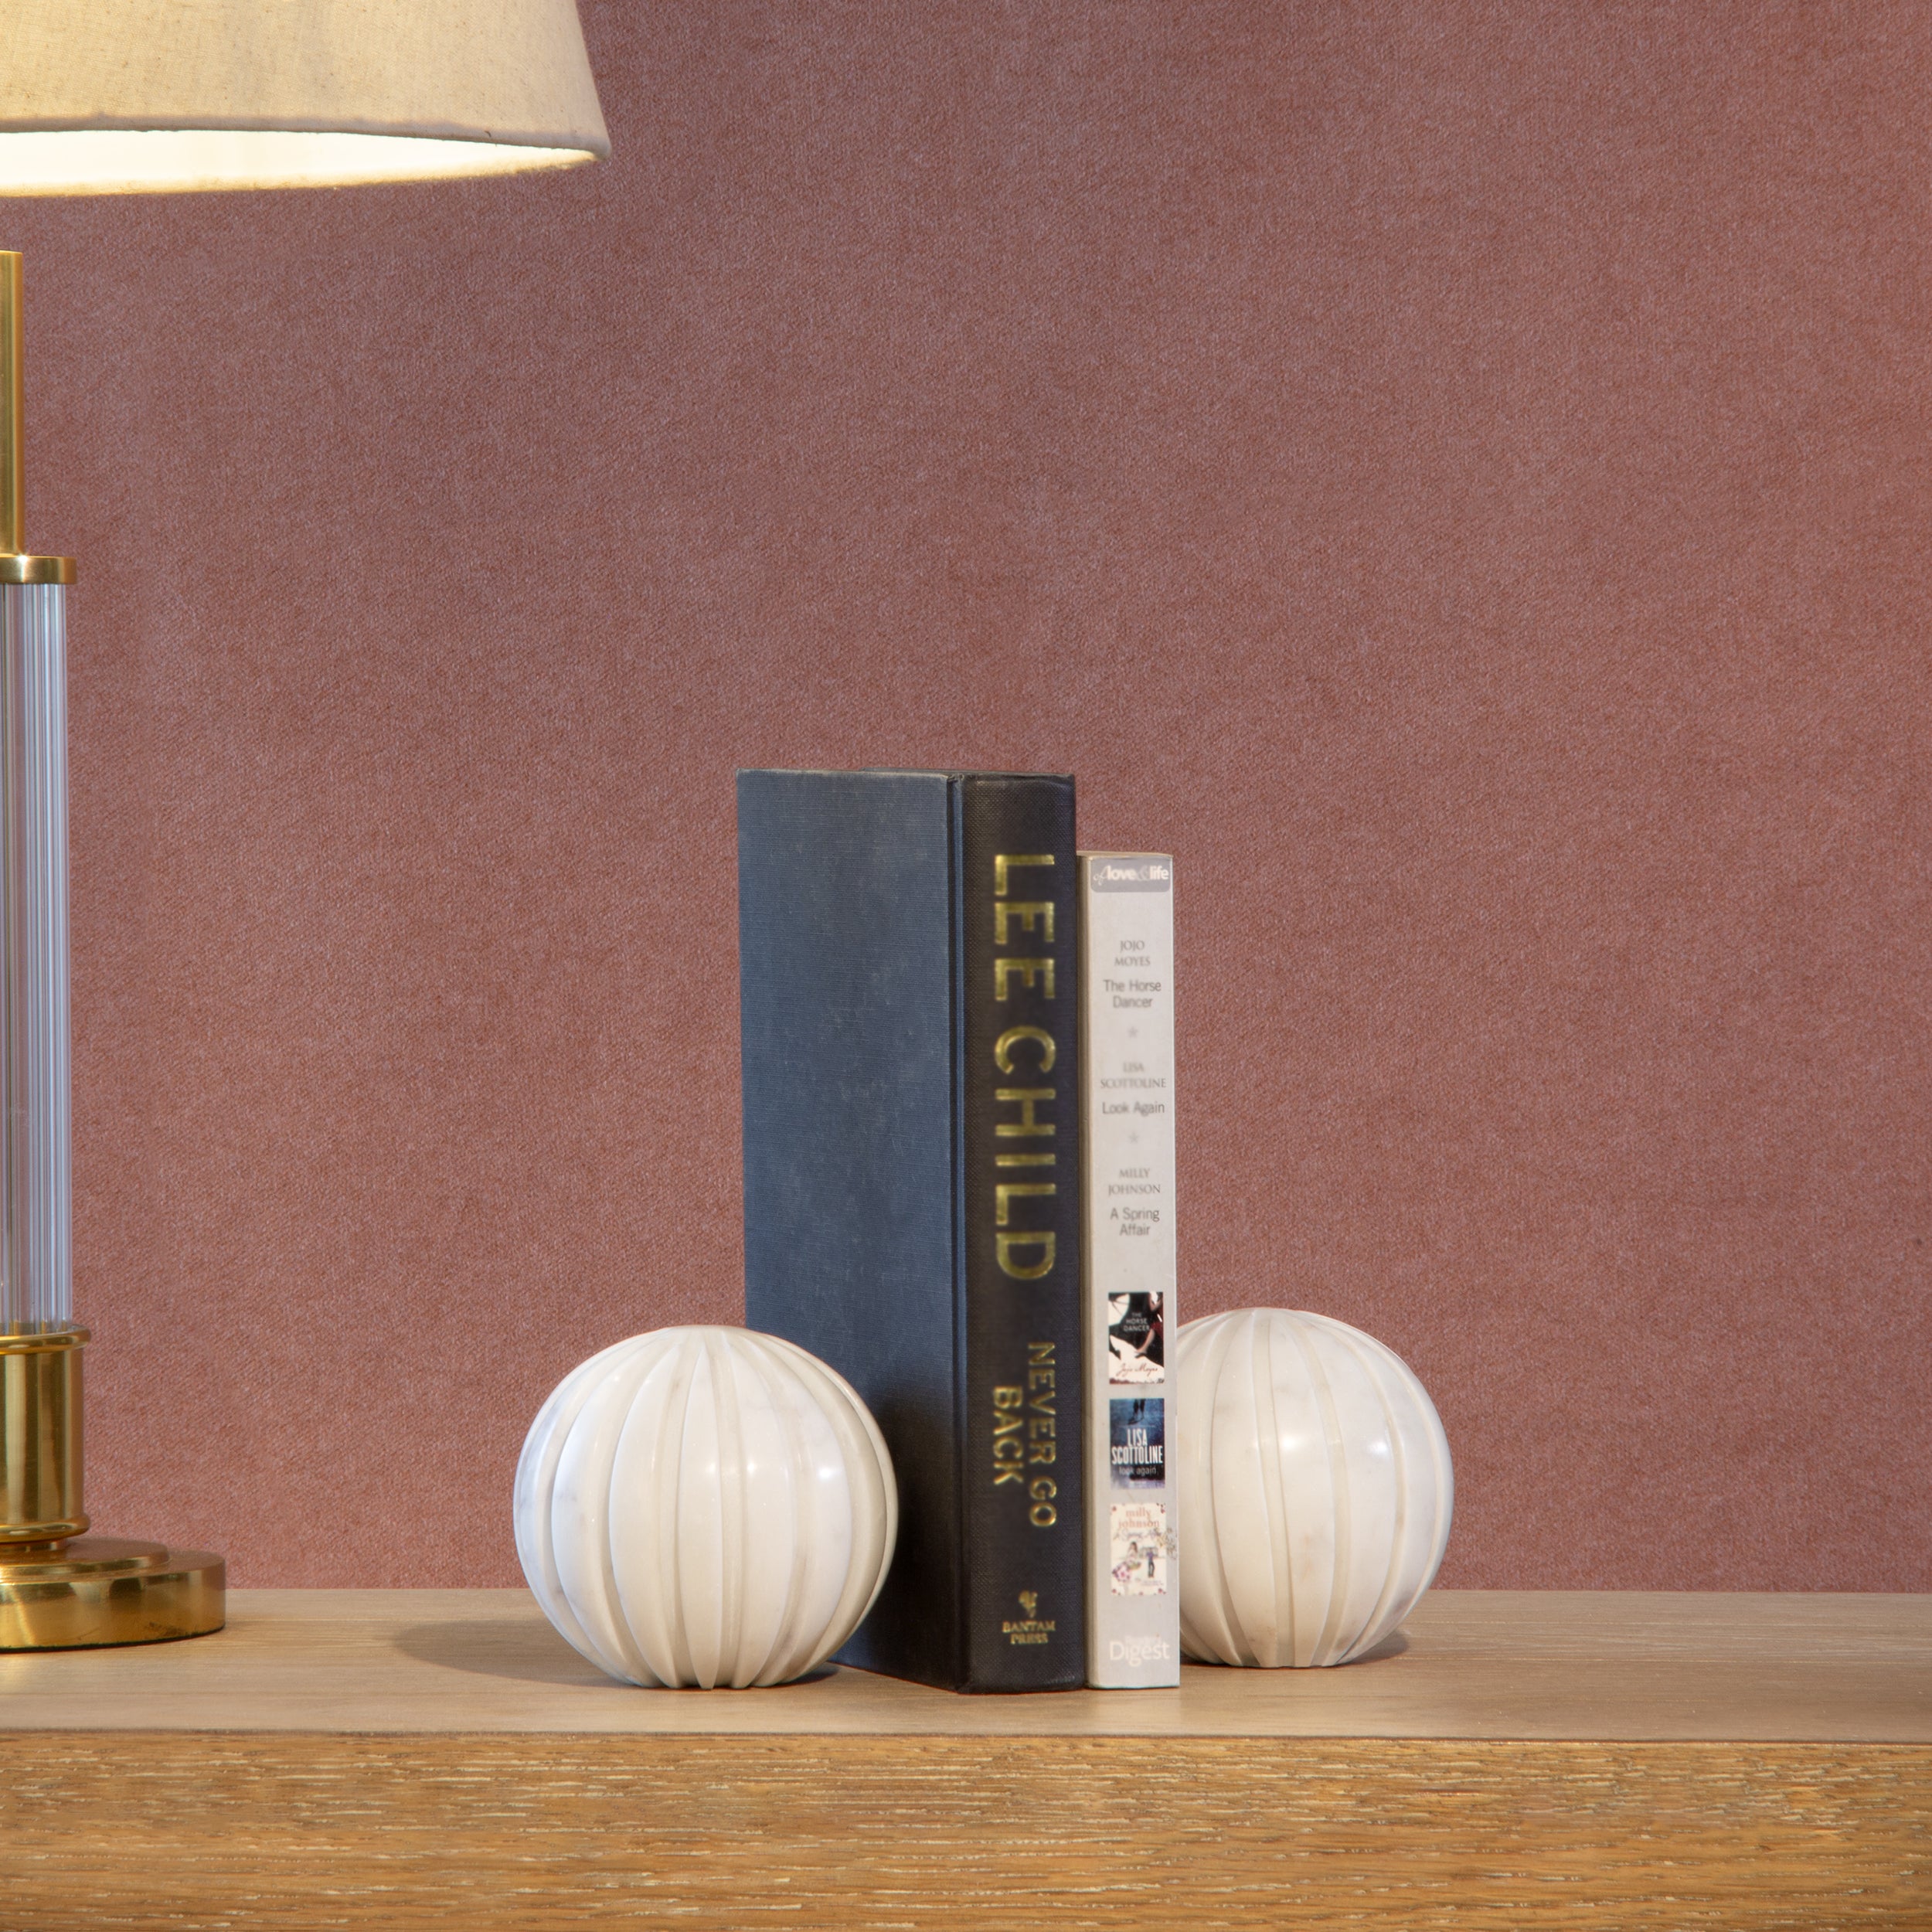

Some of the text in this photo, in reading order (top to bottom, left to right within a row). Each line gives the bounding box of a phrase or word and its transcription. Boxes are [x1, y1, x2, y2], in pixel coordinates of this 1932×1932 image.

[1120, 940, 1145, 952] JOJO
[1114, 956, 1151, 967] MOYES
[1104, 979, 1162, 992] The Horse
[1113, 996, 1153, 1009] Dancer
[995, 854, 1056, 1280] LEE CHILD
[1123, 1062, 1145, 1073] LISA
[1100, 1077, 1167, 1089] SCOTTOLINE
[1102, 1101, 1165, 1117] Look Again
[1119, 1168, 1151, 1179] MILLY
[1108, 1184, 1162, 1196] JOHNSON
[1110, 1207, 1160, 1222] A Spring
[1120, 1223, 1151, 1236] Affair
[993, 1386, 1023, 1485] BACK
[1028, 1342, 1057, 1527] NEVER GO
[1127, 1428, 1148, 1447] LISA
[1111, 1445, 1163, 1465] SCOTTOLINE
[1125, 1507, 1151, 1519] milly
[1117, 1519, 1160, 1530] johnson
[1002, 1620, 1056, 1634] BANTAM
[1010, 1632, 1049, 1645] PRESS
[1109, 1640, 1171, 1668] Digest
